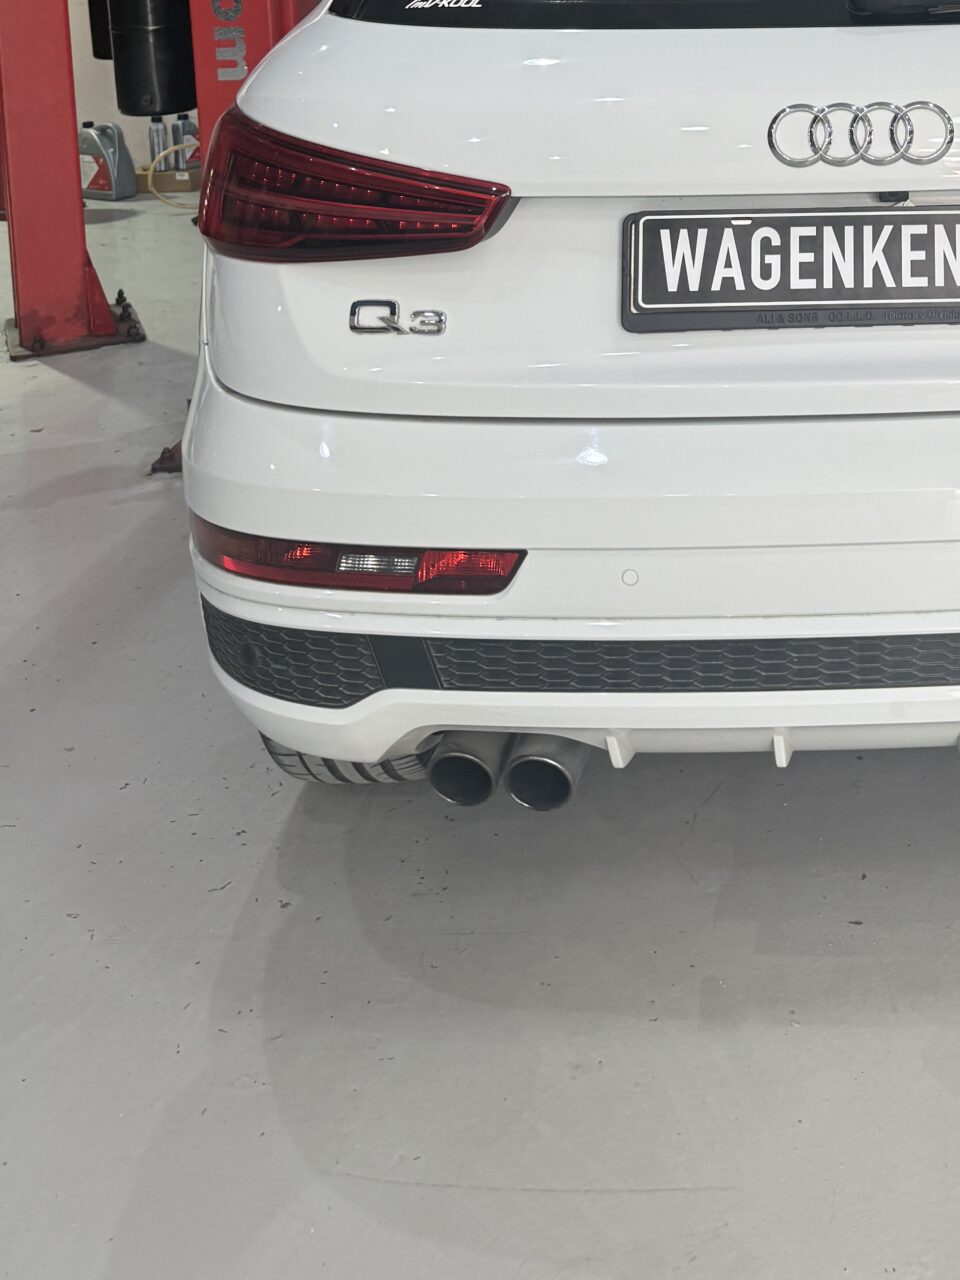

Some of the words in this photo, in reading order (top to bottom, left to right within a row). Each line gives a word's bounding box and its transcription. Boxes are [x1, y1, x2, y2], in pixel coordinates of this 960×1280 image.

[348, 299, 447, 336] Q3
[756, 313, 774, 324] ALI
[787, 312, 818, 324] SONS
